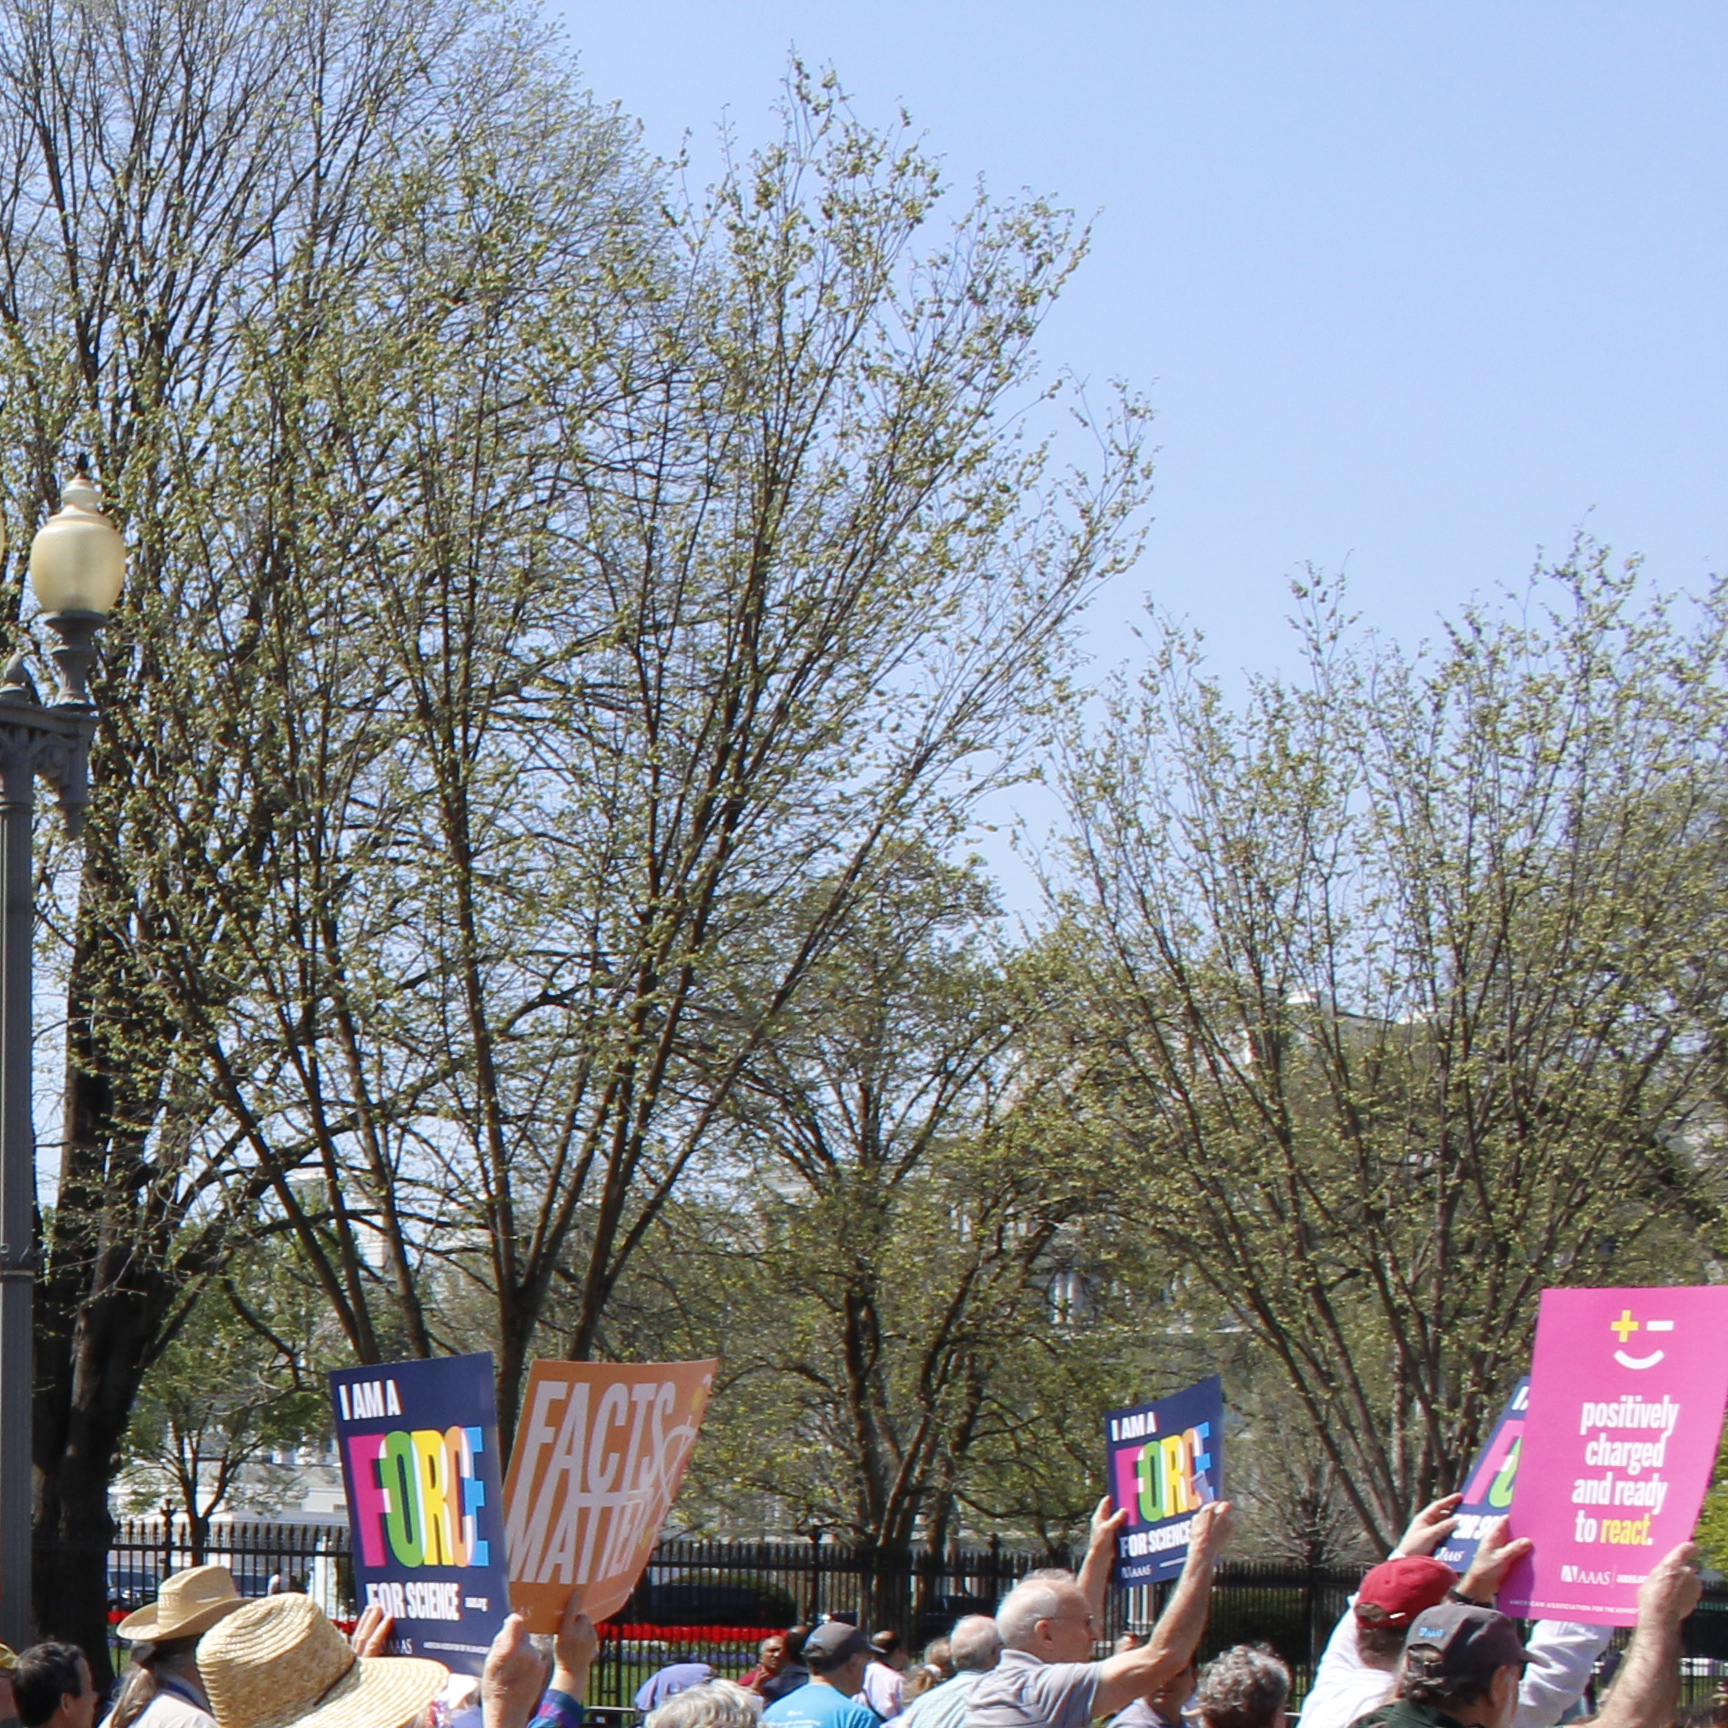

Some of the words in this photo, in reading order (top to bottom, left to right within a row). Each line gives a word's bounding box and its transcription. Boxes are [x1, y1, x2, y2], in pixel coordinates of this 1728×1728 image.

[339, 1384, 351, 1421] I
[352, 1380, 384, 1420] AM
[385, 1379, 402, 1417] A
[1579, 1394, 1680, 1438] positively
[514, 1381, 676, 1502] FACTS
[1110, 1418, 1119, 1442] I
[1121, 1414, 1146, 1440] AM
[1145, 1411, 1157, 1435] A
[1115, 1421, 1214, 1526] FORCE
[1585, 1432, 1667, 1476] charged
[348, 1425, 490, 1569] FORCE
[1571, 1471, 1613, 1505] and
[1614, 1472, 1669, 1516] ready
[506, 1487, 656, 1584] MATTER
[1119, 1532, 1148, 1559] FOR
[1147, 1520, 1192, 1554] SCIENCE
[1574, 1509, 1597, 1543] to
[1600, 1512, 1654, 1546] react.
[1577, 1571, 1611, 1585] AAAS
[366, 1582, 406, 1619] FOR
[405, 1582, 462, 1621] SCIENCE
